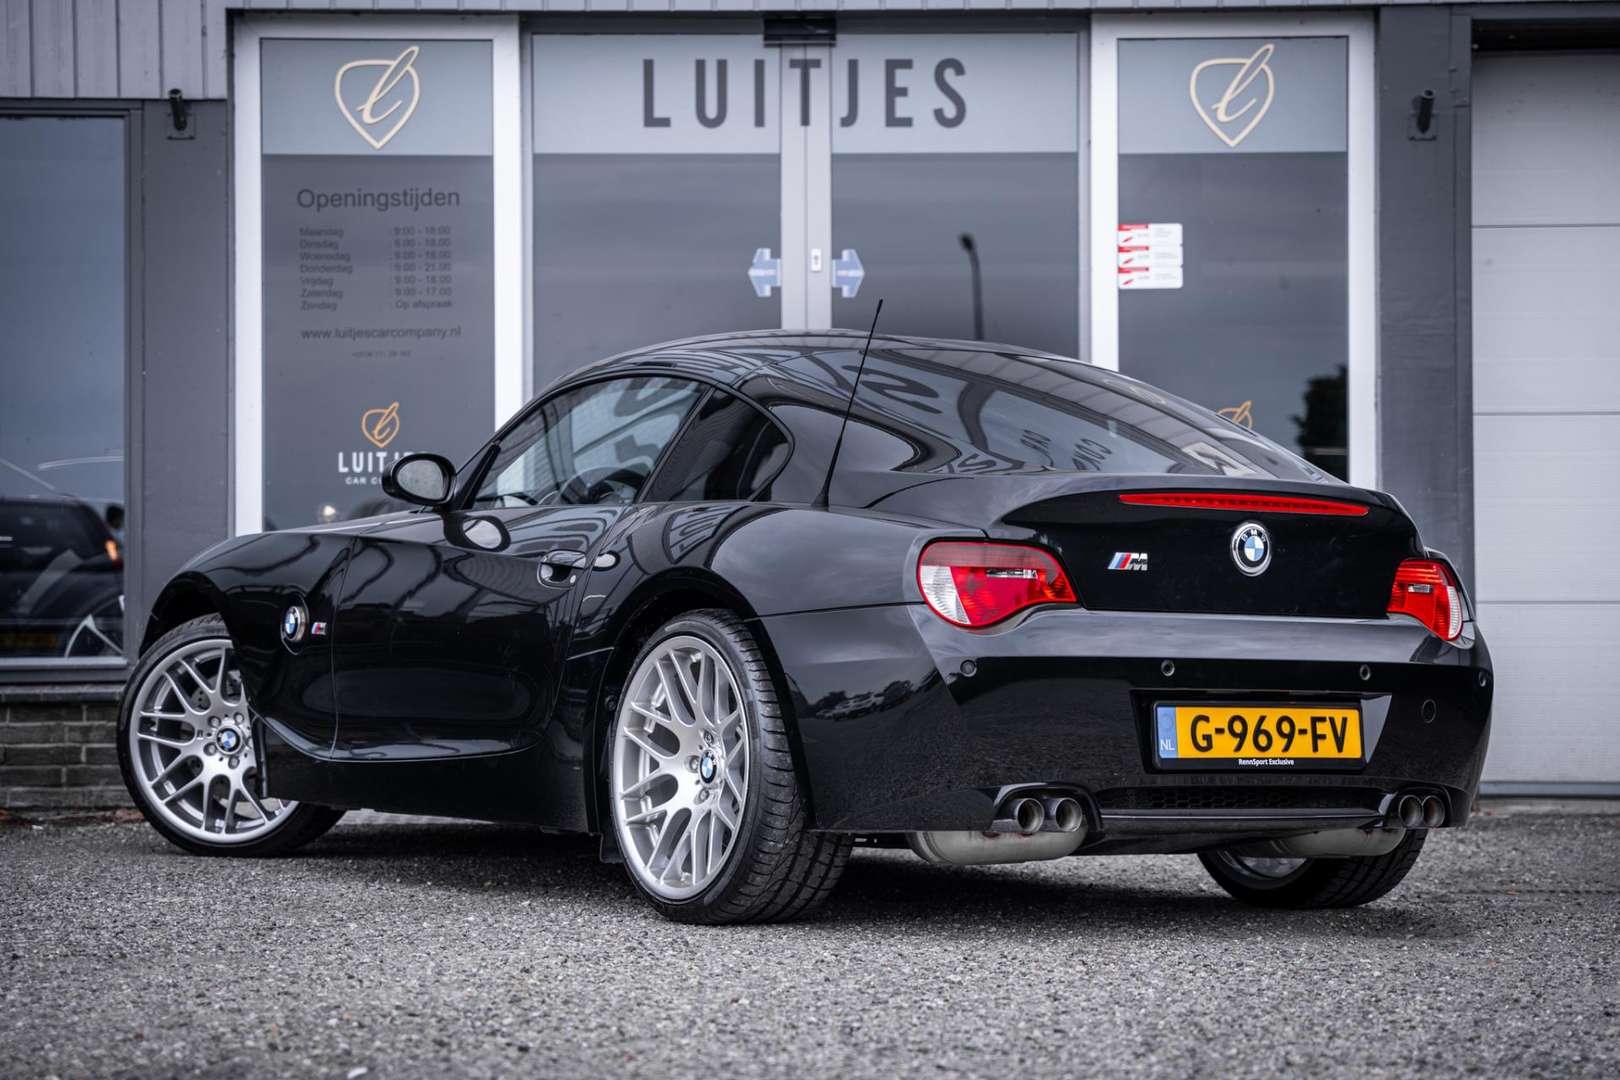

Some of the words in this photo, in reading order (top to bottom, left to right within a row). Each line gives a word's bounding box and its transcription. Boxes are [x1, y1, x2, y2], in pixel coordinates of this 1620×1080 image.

[643, 58, 967, 129] LUITJES
[297, 188, 460, 212] Openingstijden
[300, 325, 461, 341] www.luitjescarcompany.nl
[1190, 714, 1348, 753] G-969-FV
[1160, 739, 1175, 751] NL
[1238, 758, 1267, 767] RennSport
[1268, 758, 1294, 766] Exclusive
